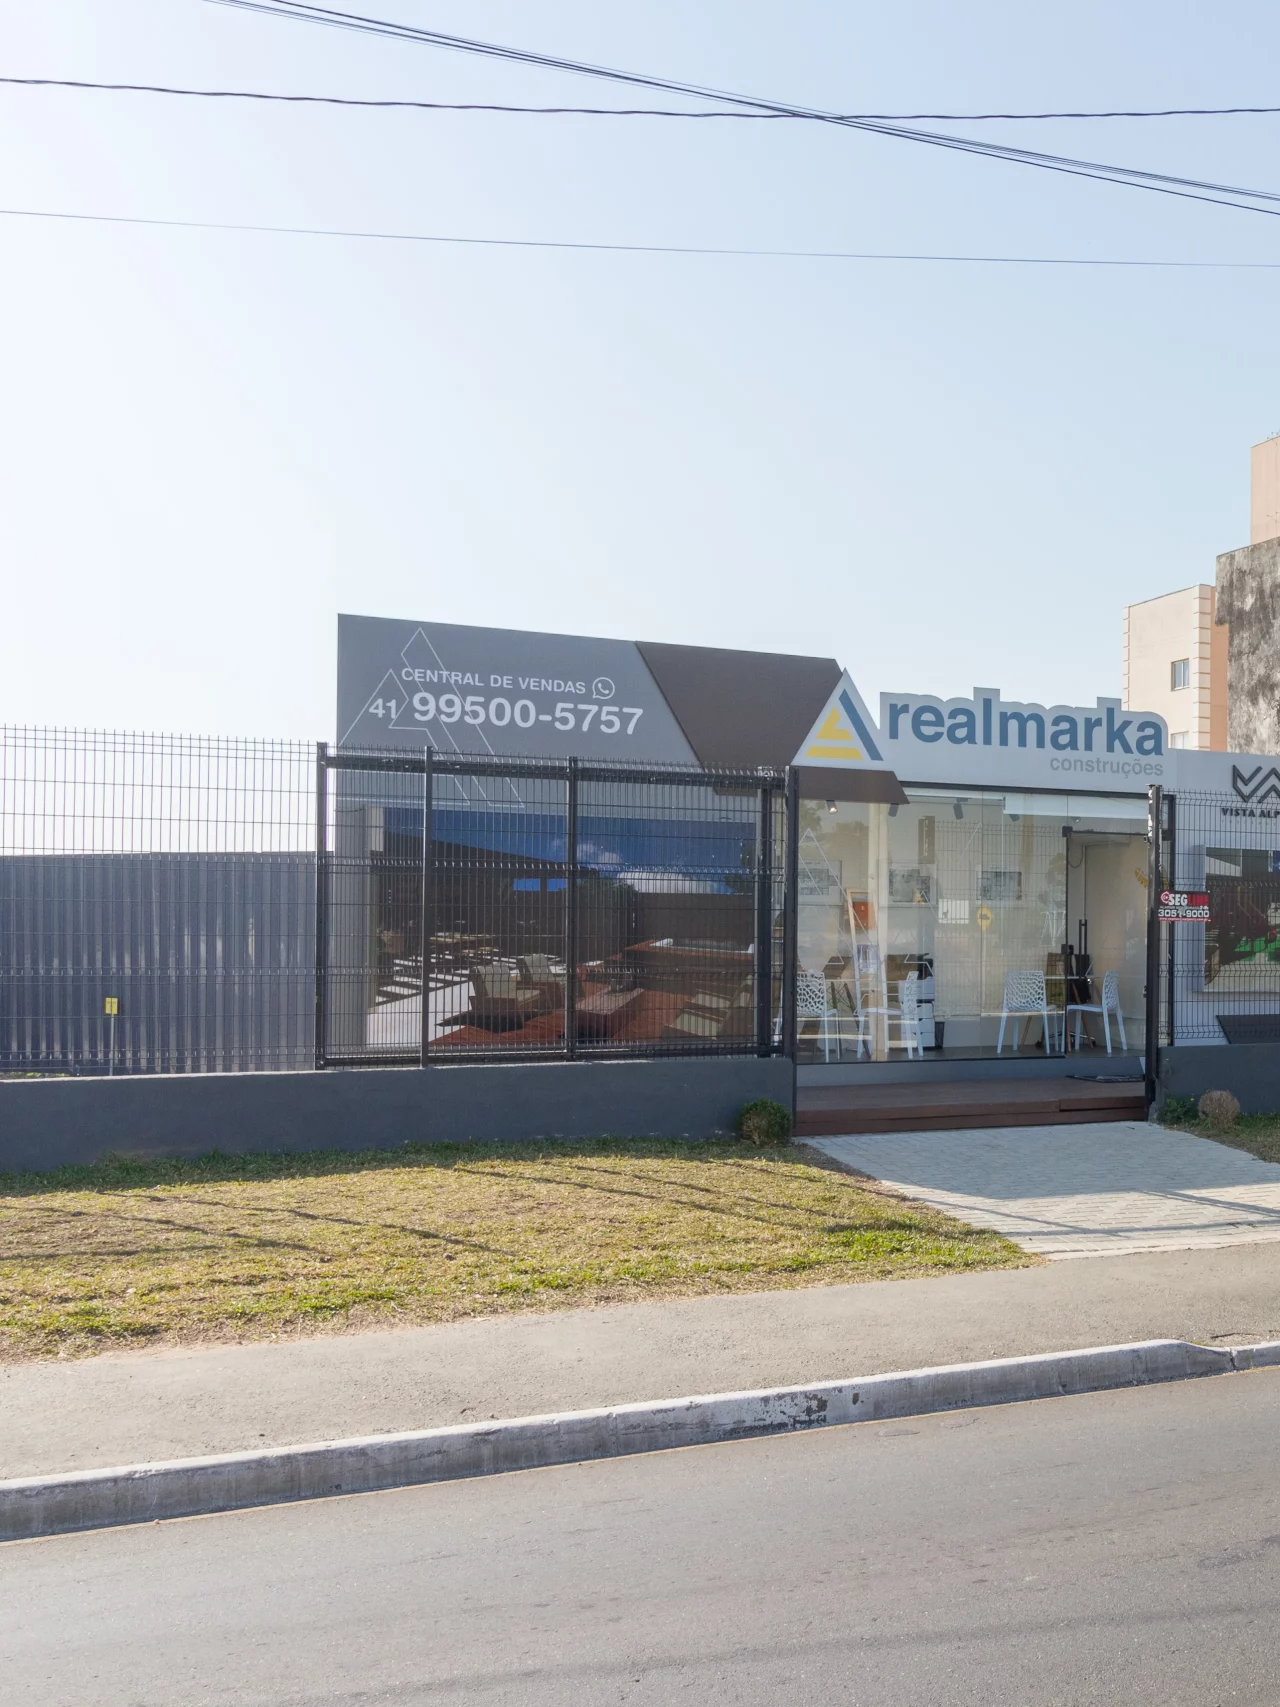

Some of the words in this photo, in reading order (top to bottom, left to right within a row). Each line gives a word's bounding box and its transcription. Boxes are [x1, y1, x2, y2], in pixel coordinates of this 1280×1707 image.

[401, 667, 484, 687] CENTRAL
[490, 675, 514, 690] DE
[518, 677, 586, 694] VENDAS
[368, 698, 397, 719] 41
[412, 691, 644, 735] 99500-5757
[888, 697, 1164, 756] realmarka
[1050, 757, 1164, 779] construções
[1222, 807, 1256, 818] VISTA
